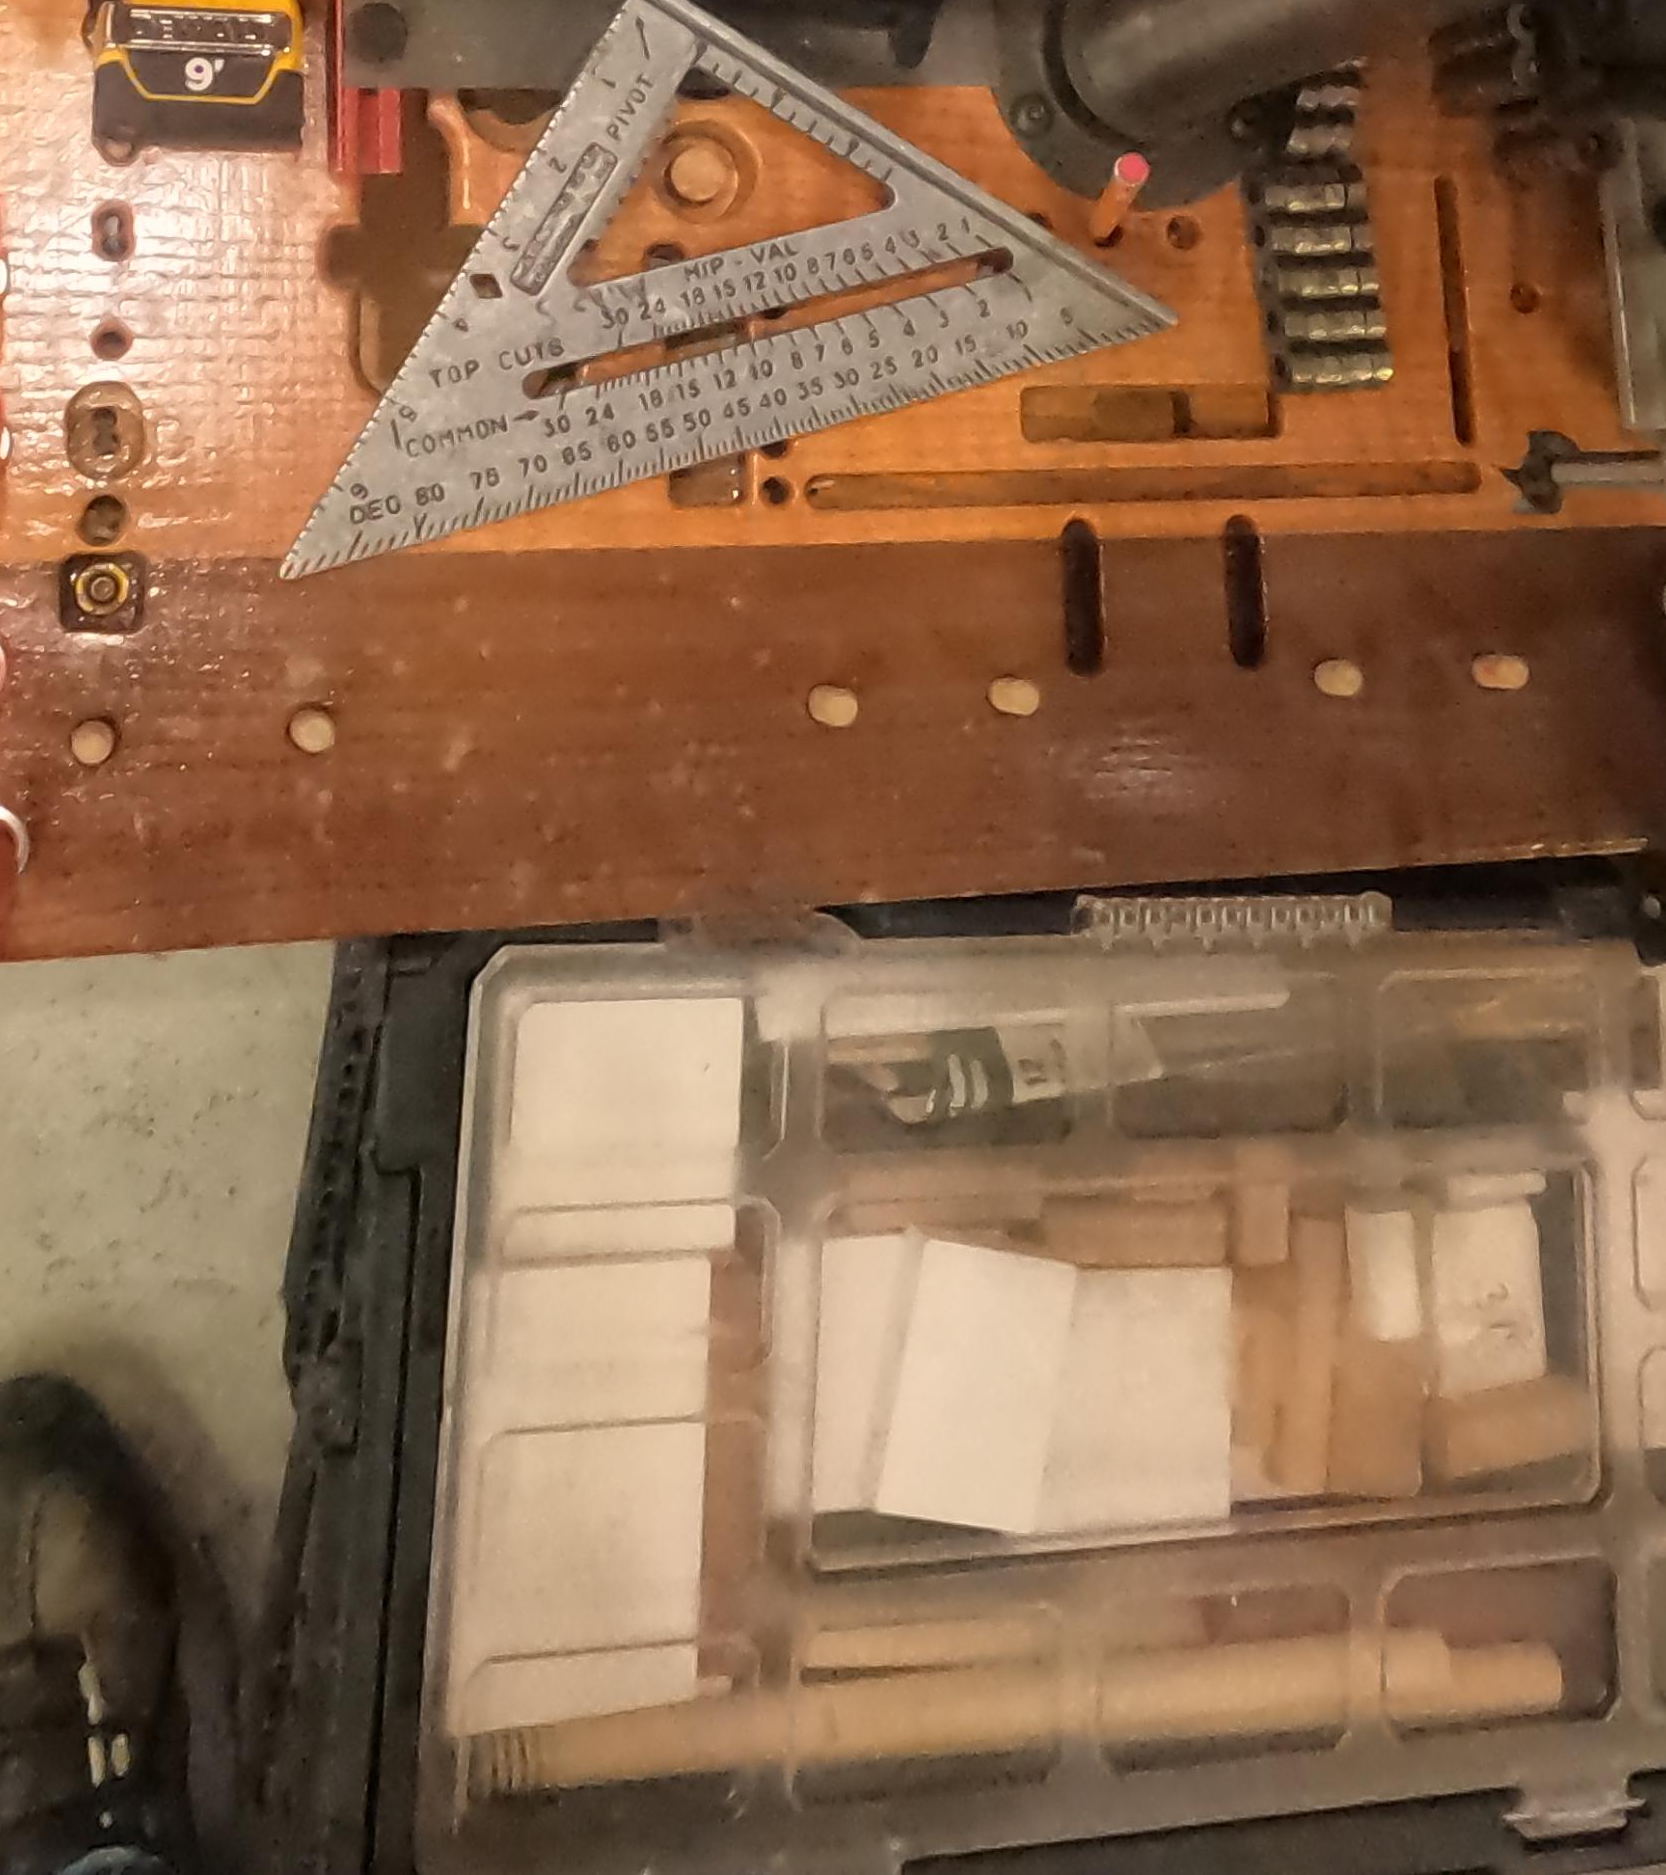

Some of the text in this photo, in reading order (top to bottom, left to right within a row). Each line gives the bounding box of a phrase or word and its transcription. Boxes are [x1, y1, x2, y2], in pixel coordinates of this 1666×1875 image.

[185, 57, 225, 91] 9'
[605, 73, 656, 142] PIVOT
[547, 157, 567, 174] 2
[638, 297, 666, 320] 24
[680, 287, 706, 308] 18
[713, 279, 736, 300] 15
[743, 271, 766, 293] 12
[774, 262, 797, 282] 10
[824, 252, 836, 271] 7
[884, 236, 897, 254] 4
[937, 223, 949, 242] 2
[961, 215, 970, 234] 1
[749, 240, 799, 264] VAL
[454, 317, 469, 333] 4
[405, 413, 508, 458] COMMON
[585, 403, 615, 426] 24
[638, 388, 663, 411] 18
[675, 378, 701, 400] 15
[713, 369, 736, 390] 12
[749, 359, 773, 381] 10
[790, 351, 804, 369] 8
[815, 343, 825, 362] 7
[867, 328, 880, 349] 5
[903, 319, 916, 336] 4
[938, 310, 950, 328] 3
[979, 299, 990, 318] 2
[429, 336, 565, 388] TOP CUTS
[415, 483, 445, 507] 80
[517, 454, 548, 478] 70
[683, 408, 712, 433] 50
[723, 397, 751, 419] 45
[760, 388, 787, 409] 40
[797, 377, 824, 401] 35
[833, 368, 860, 389] 30
[869, 356, 897, 380] 25
[911, 345, 938, 368] 20
[955, 334, 977, 355] 15
[1006, 319, 1028, 340] 10
